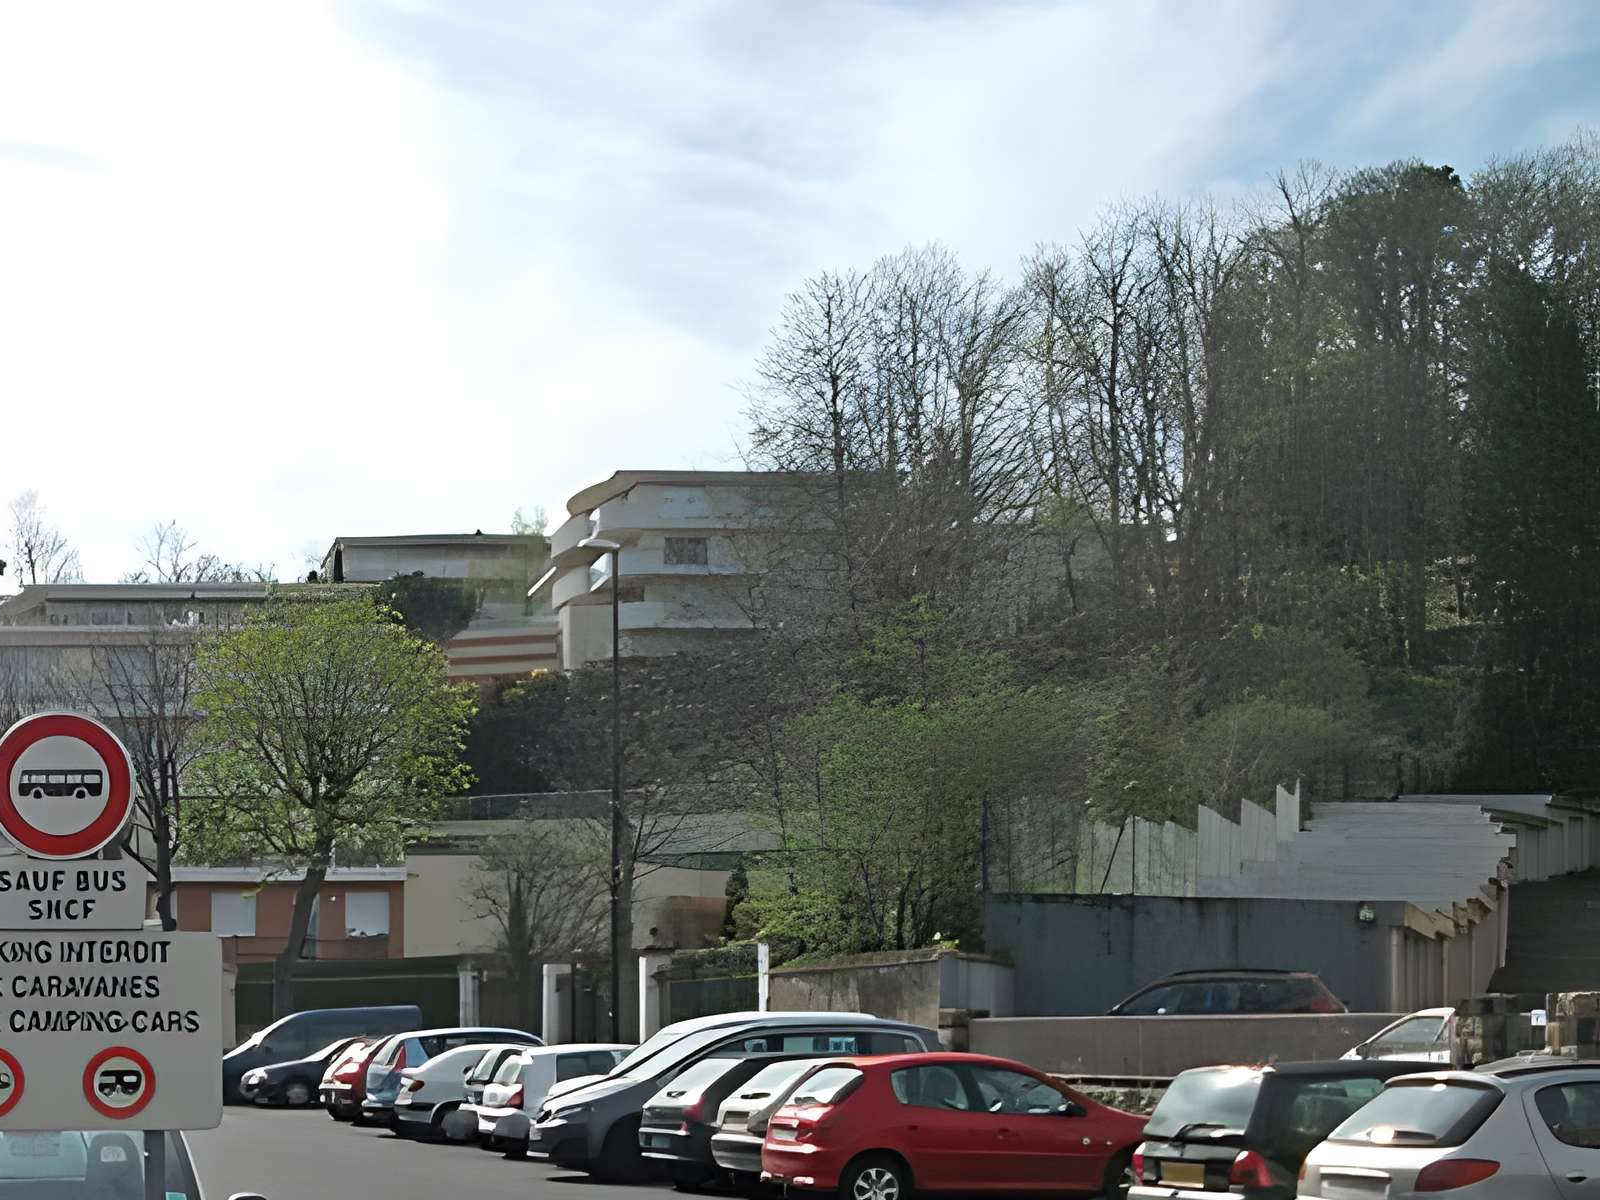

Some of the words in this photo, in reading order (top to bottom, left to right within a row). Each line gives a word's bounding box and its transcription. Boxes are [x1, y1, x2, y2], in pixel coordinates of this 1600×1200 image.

[76, 870, 127, 892] BUS
[60, 940, 171, 963] INTERDIT
[12, 975, 160, 998] CARAVANES
